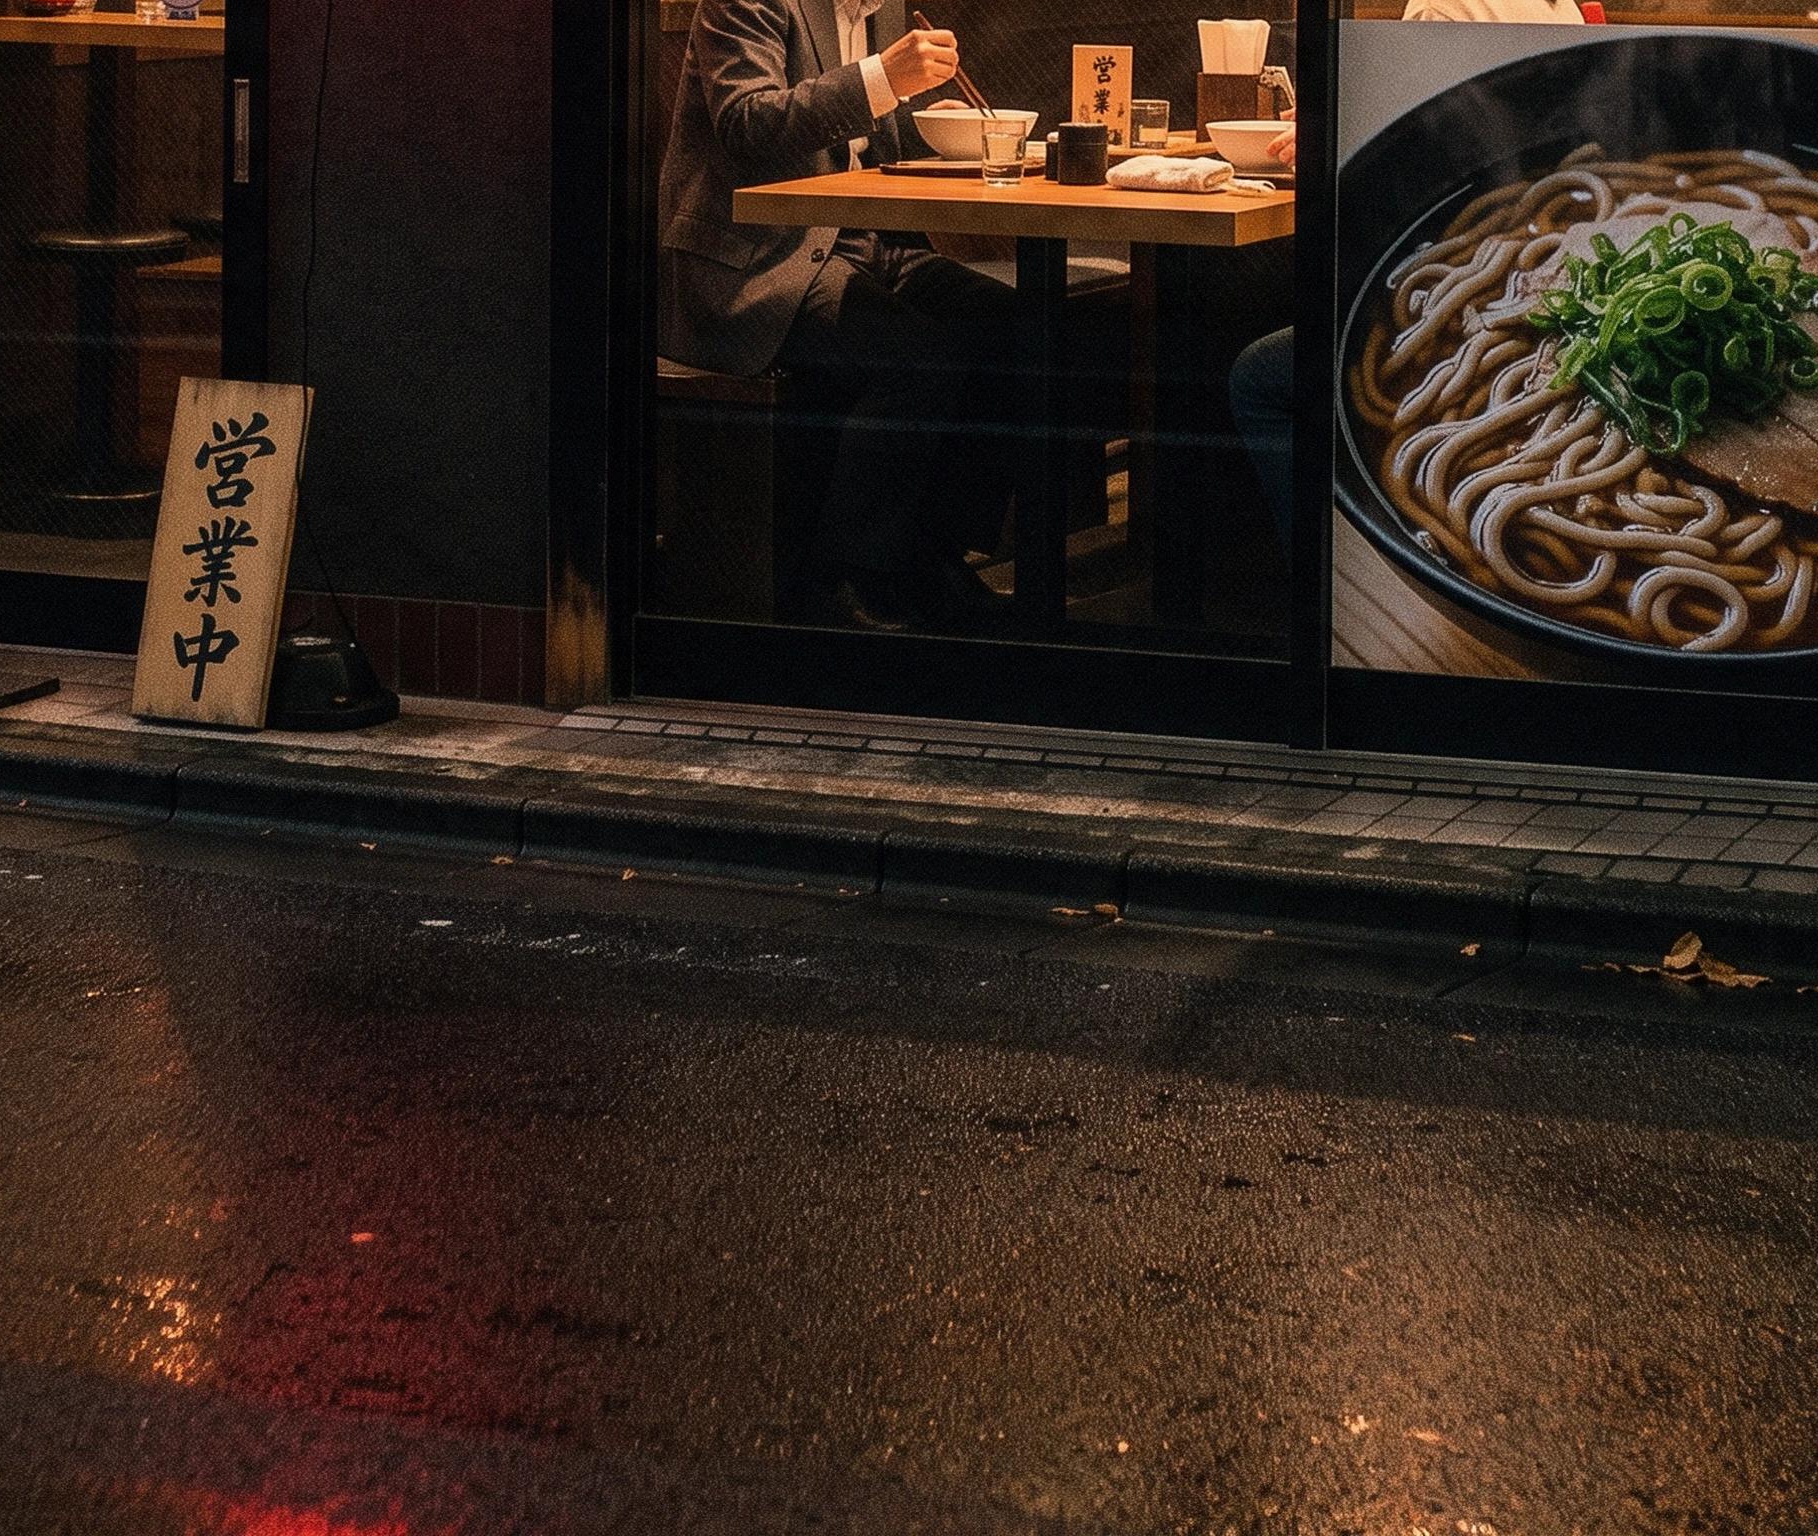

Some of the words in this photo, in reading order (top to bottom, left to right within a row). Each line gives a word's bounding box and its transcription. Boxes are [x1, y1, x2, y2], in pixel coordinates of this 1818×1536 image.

[1093, 55, 1117, 123] 営業
[173, 412, 277, 702] 営業中
